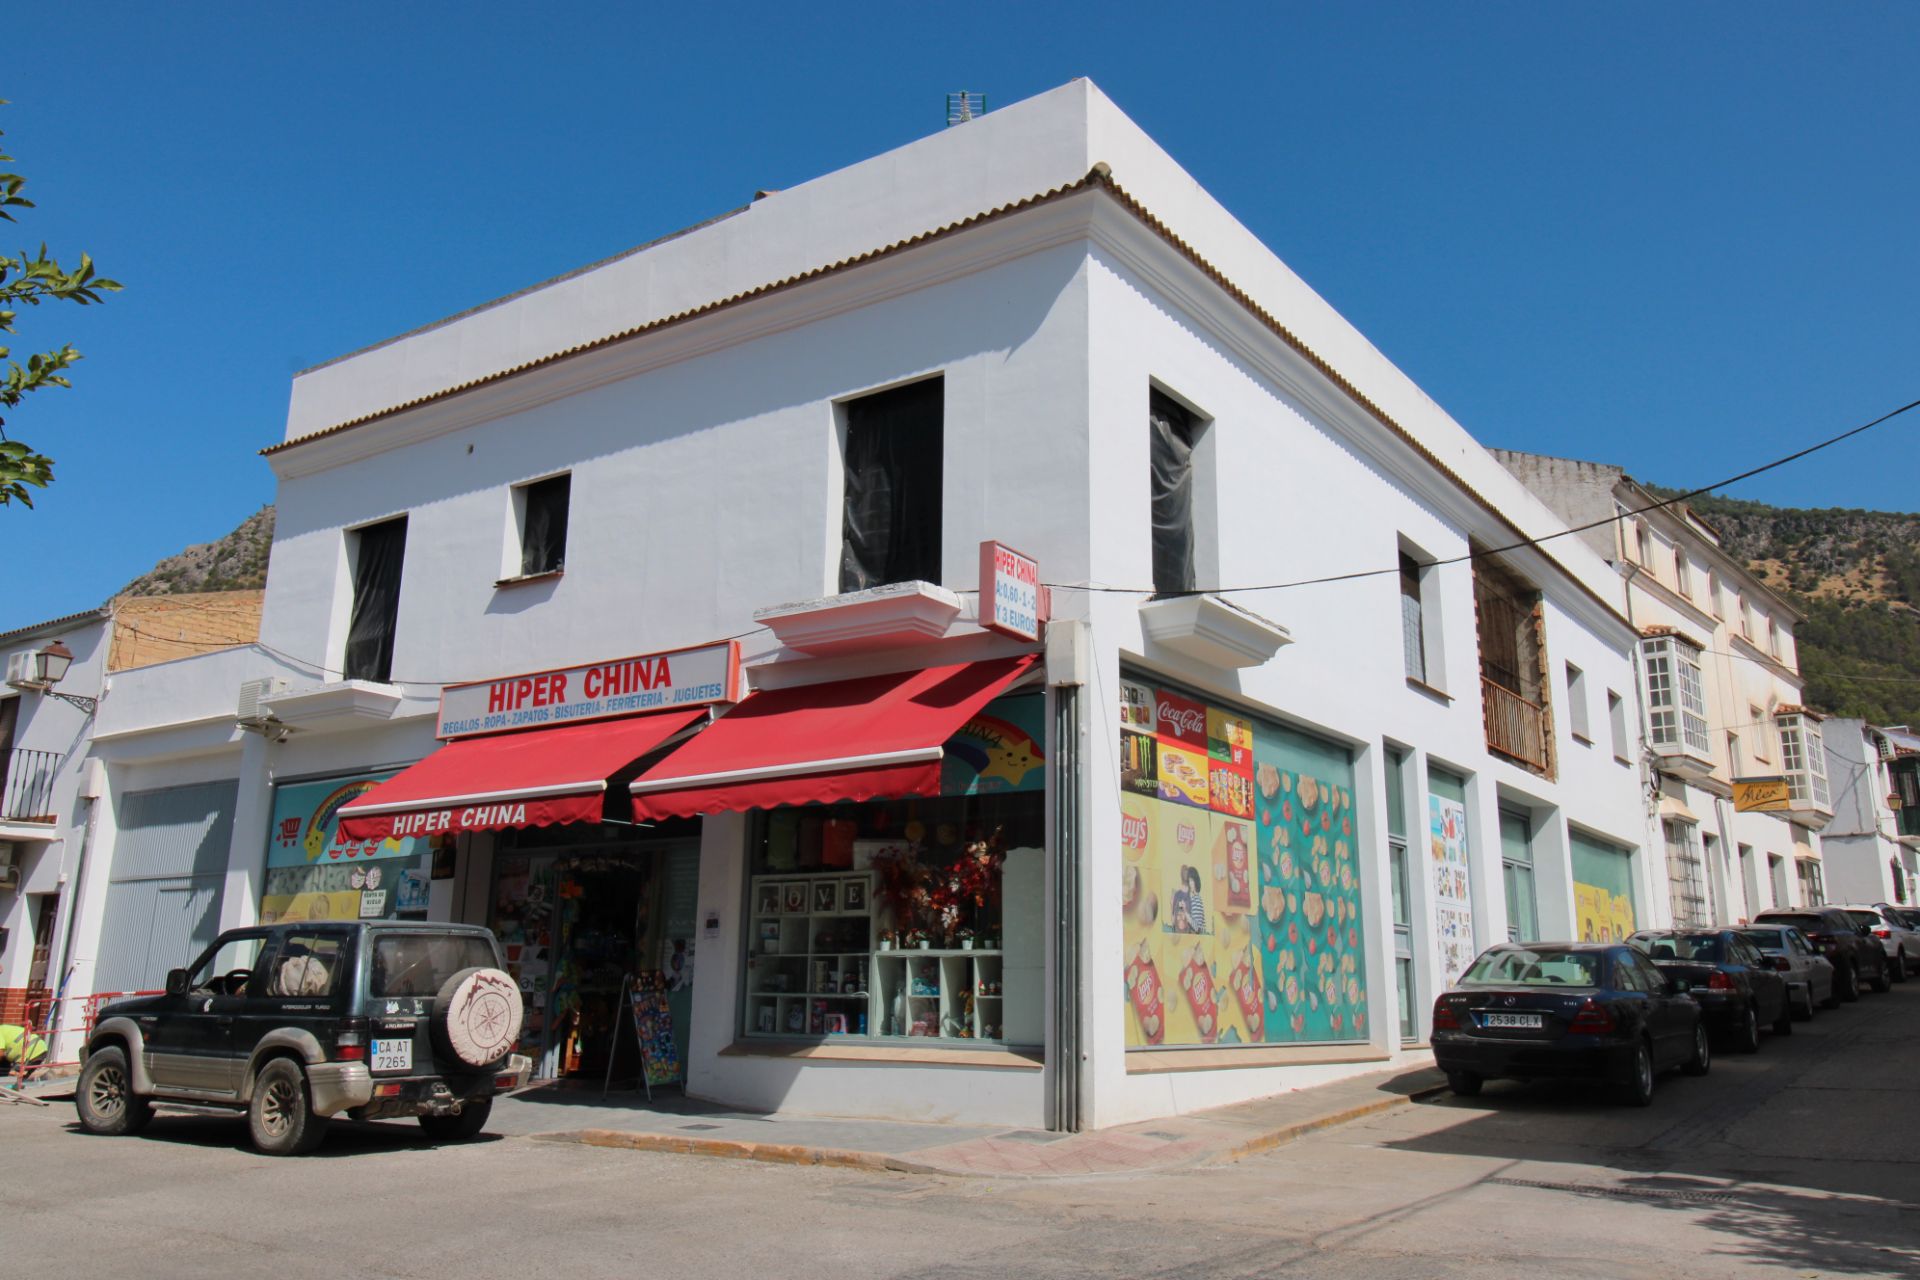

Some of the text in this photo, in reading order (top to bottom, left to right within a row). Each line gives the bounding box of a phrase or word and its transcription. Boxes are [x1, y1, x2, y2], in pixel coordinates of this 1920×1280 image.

[995, 547, 1036, 586] HIPER CHINA
[1002, 607, 1008, 622] 3
[1010, 610, 1036, 634] EUROS
[488, 656, 672, 713] HIPER CHINA
[442, 683, 722, 734] REGALOS ROPA ZAPATOS BISUTERIA FERRETERIA JUGUETES
[392, 804, 526, 835] HIPER CHINA
[1121, 818, 1147, 849] ay's
[1490, 1015, 1540, 1027] 2538 CLX
[379, 1056, 406, 1069] 7265
